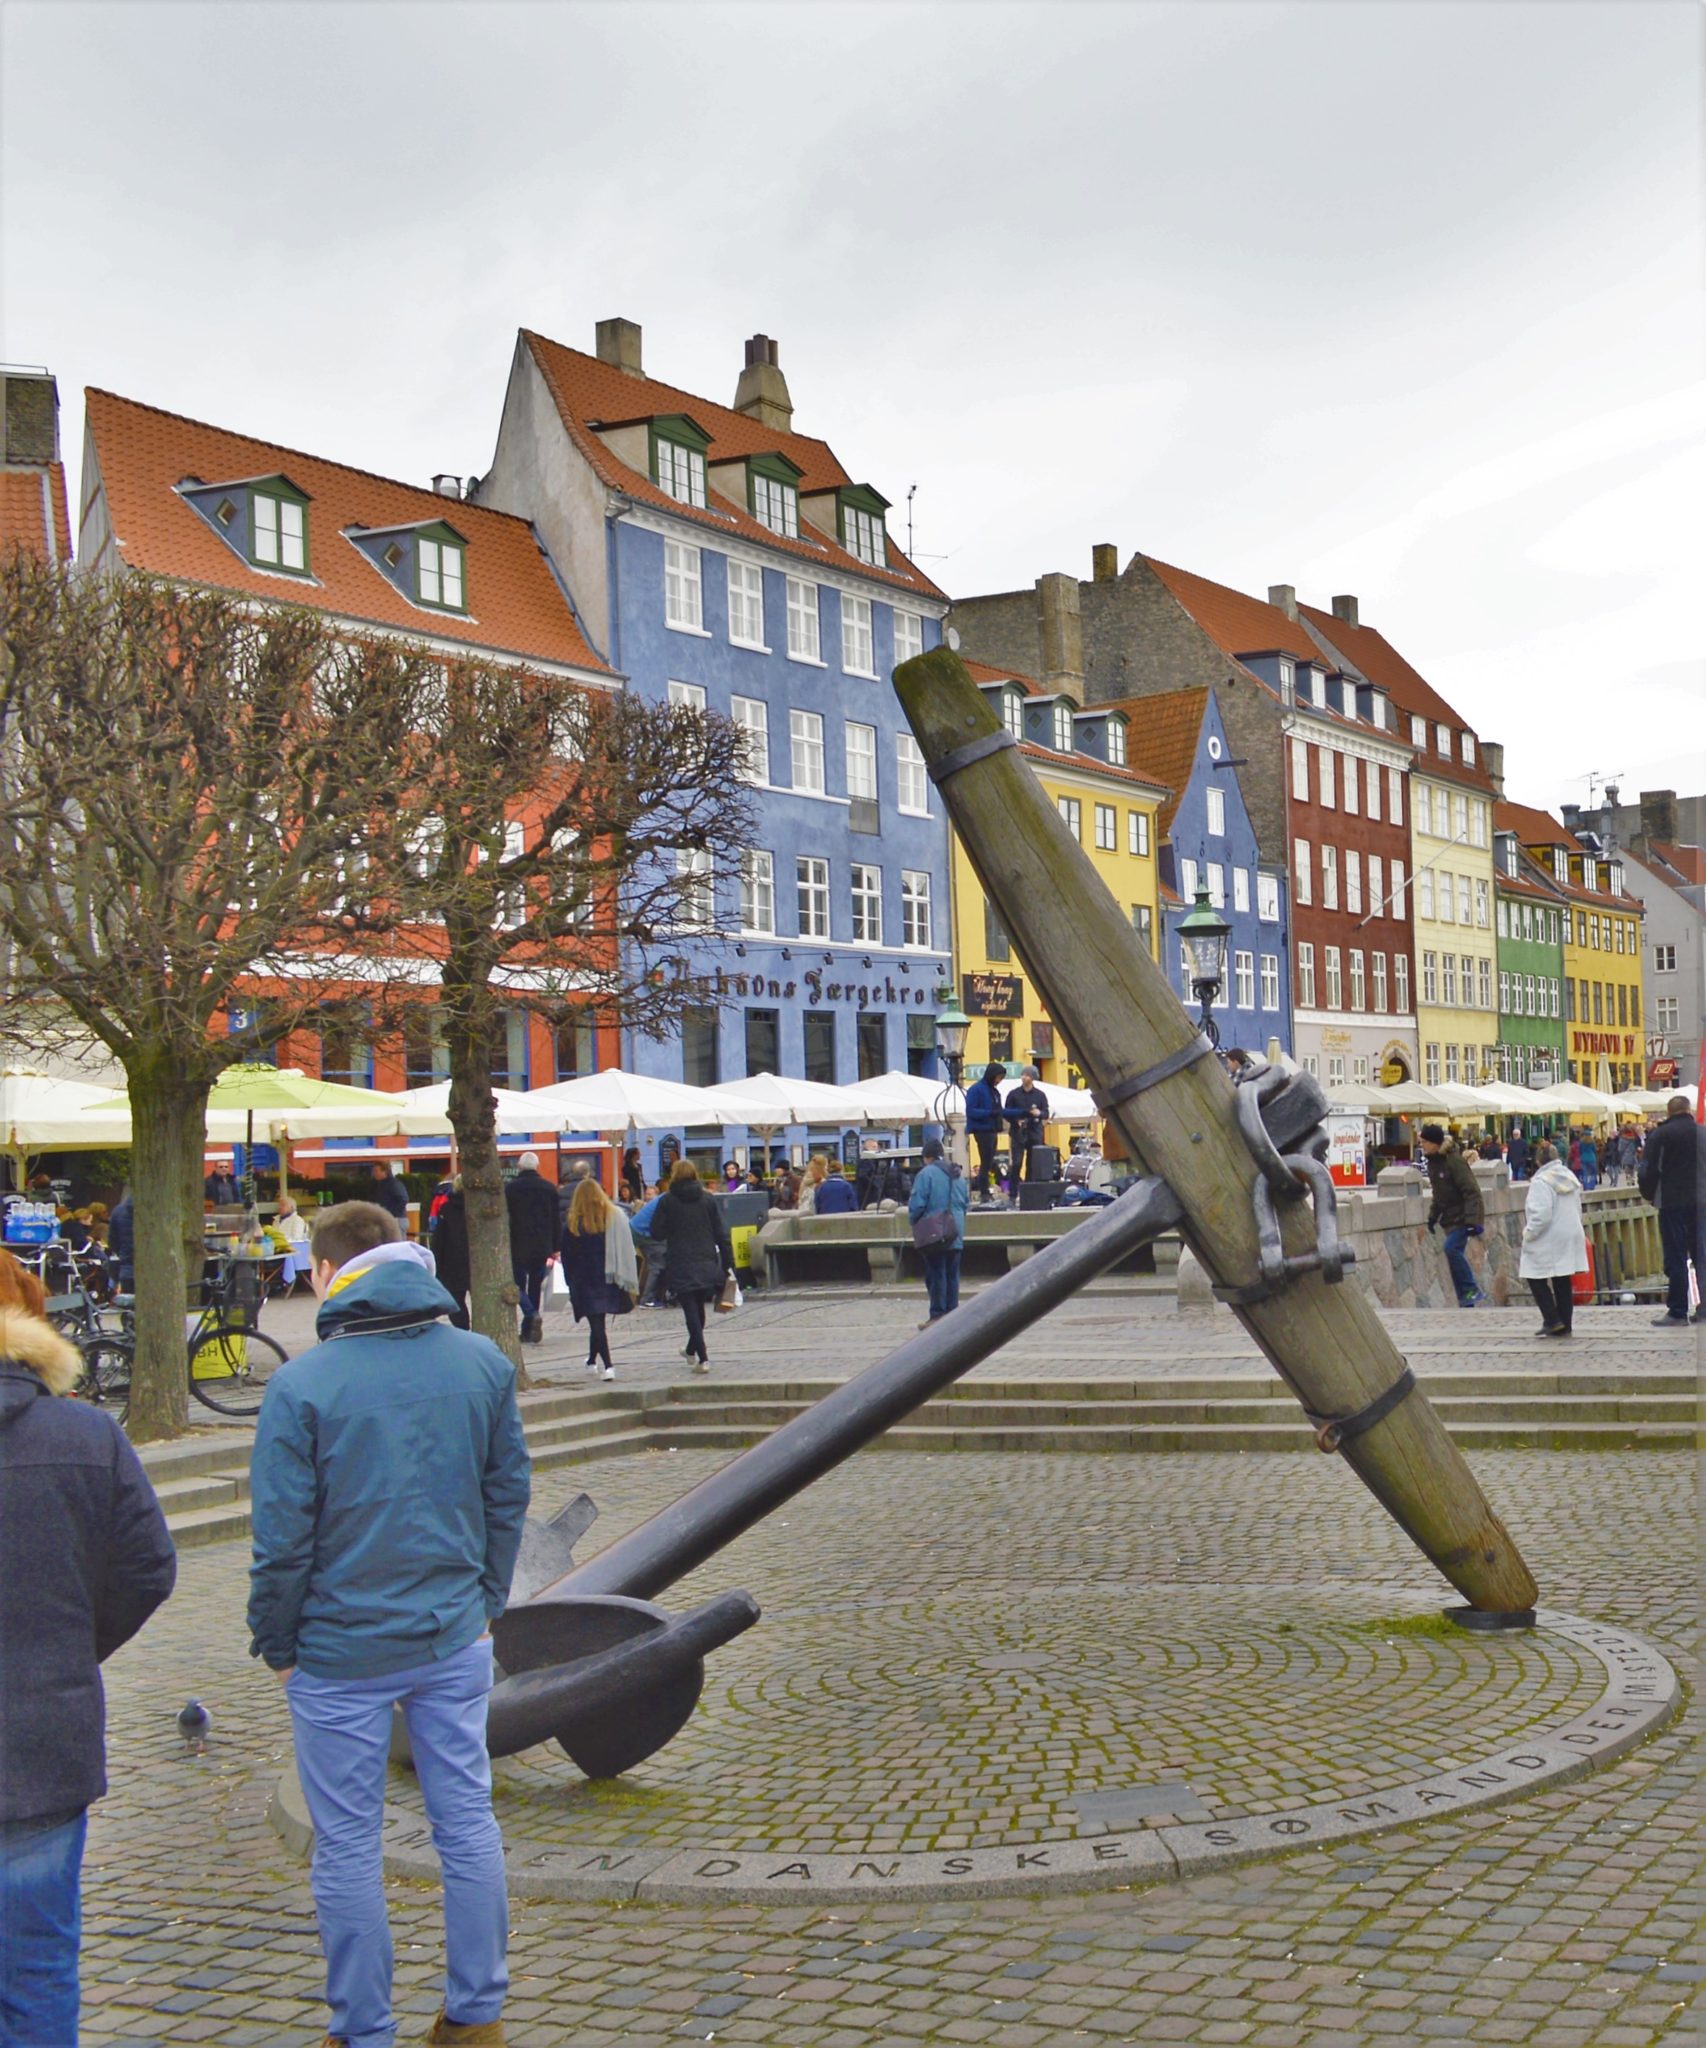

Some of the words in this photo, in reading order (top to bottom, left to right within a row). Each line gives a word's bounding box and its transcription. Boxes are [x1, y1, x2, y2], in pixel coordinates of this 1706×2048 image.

[235, 1008, 248, 1029] 3
[1573, 1031, 1620, 1055] NYHAVN
[1624, 1034, 1635, 1056] 17
[1647, 1036, 1665, 1057] 17
[1571, 1627, 1658, 1697] MISTEDE
[1560, 1706, 1643, 1745] DER
[1204, 1754, 1547, 1847] SØMAND
[692, 1842, 1129, 1880] DANSKE
